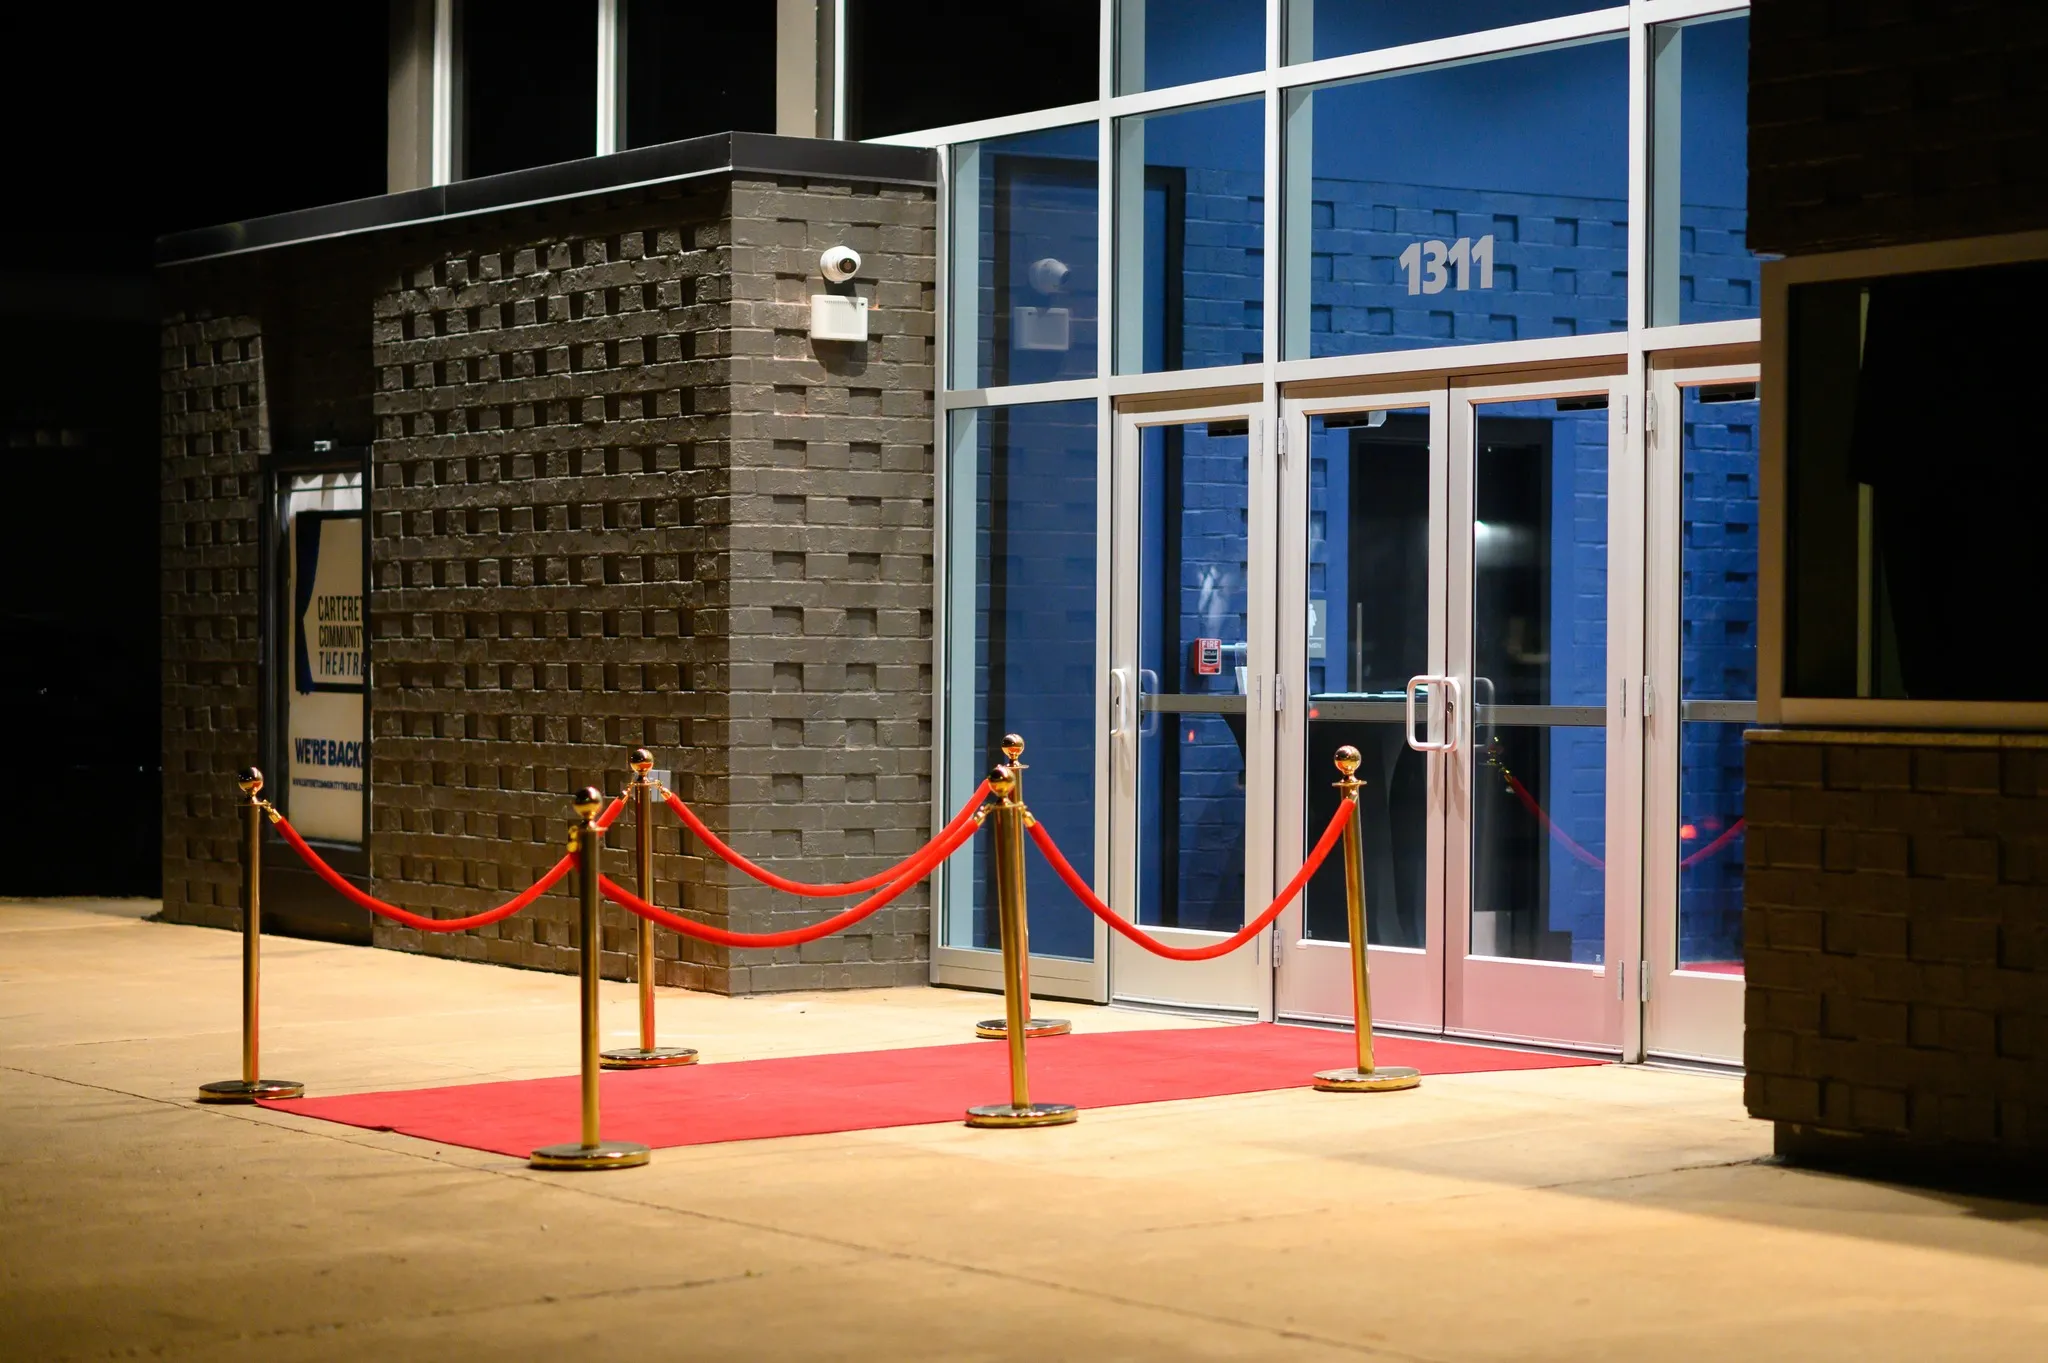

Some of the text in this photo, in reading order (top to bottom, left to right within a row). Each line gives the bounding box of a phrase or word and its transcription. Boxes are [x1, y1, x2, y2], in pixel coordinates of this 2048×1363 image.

[1399, 235, 1494, 296] 1311
[1201, 640, 1219, 649] FIRE
[294, 737, 327, 766] WE'RE
